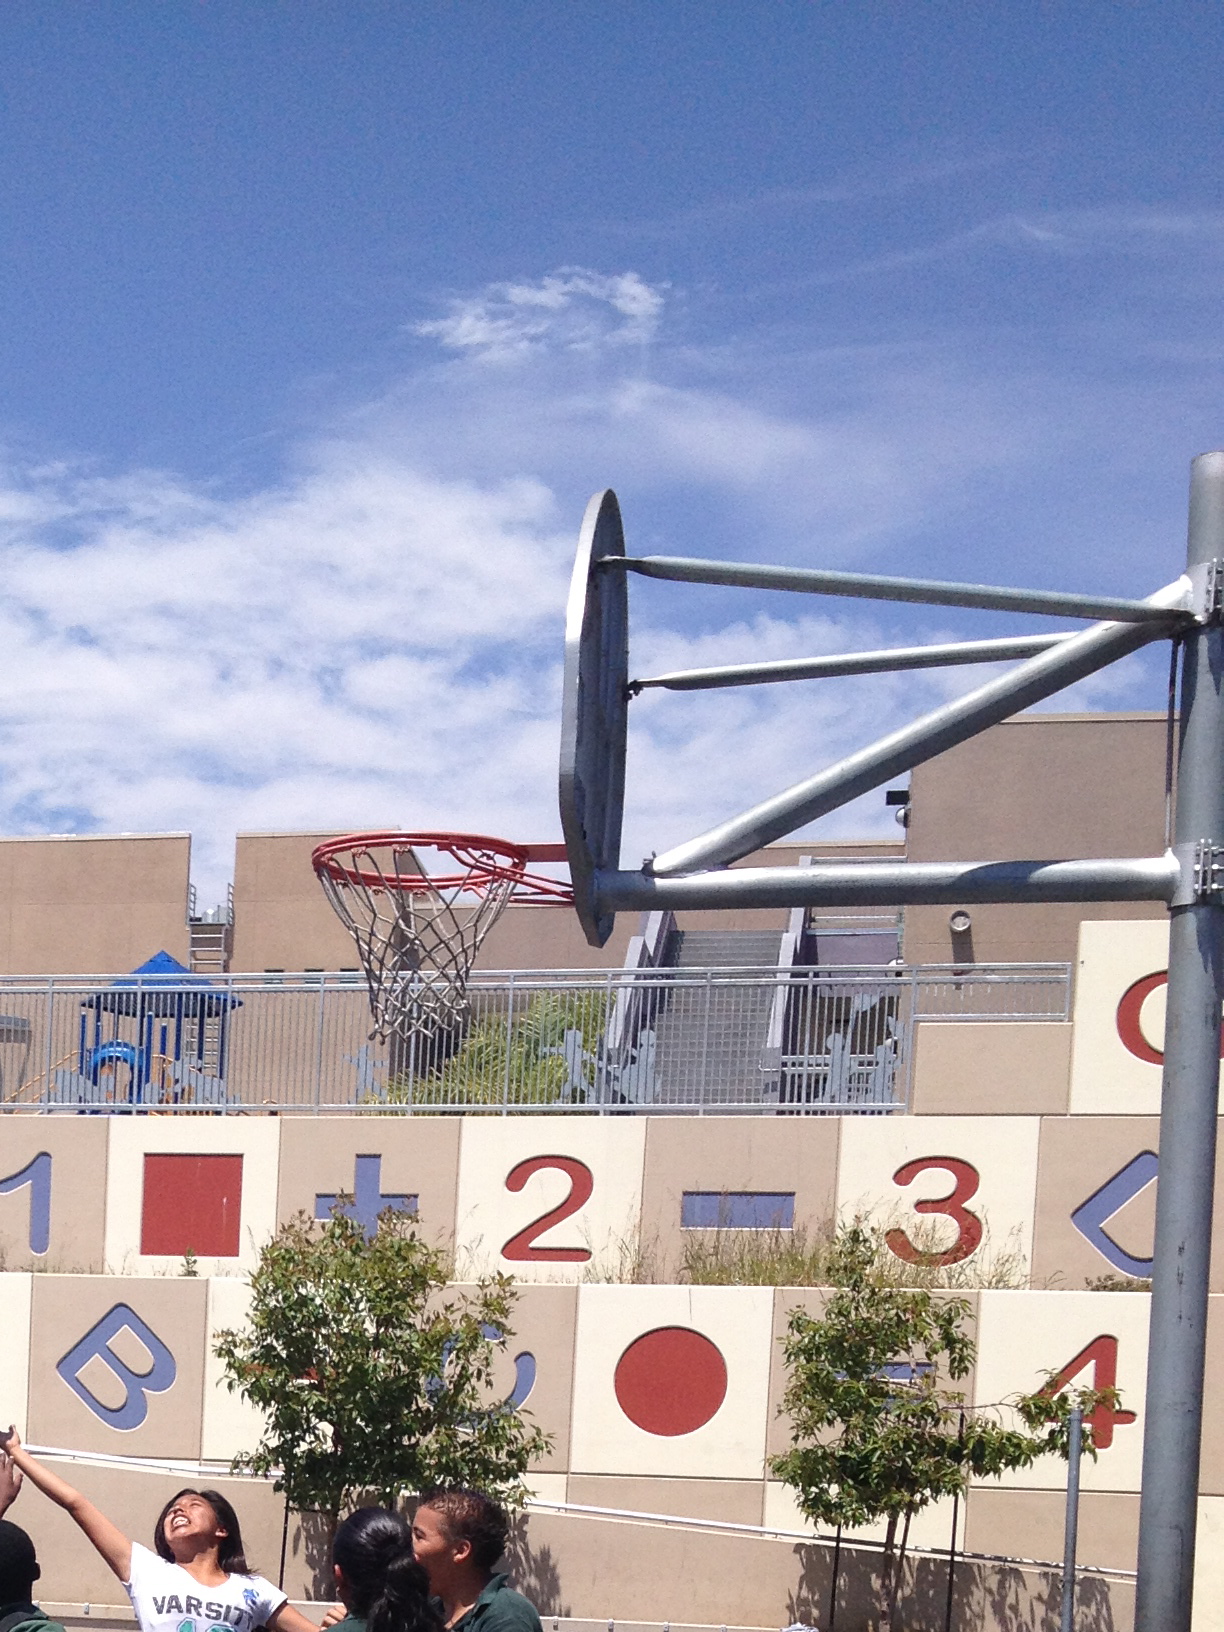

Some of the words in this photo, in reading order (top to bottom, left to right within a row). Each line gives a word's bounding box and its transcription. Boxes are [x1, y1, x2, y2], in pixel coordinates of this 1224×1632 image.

[501, 1154, 594, 1262] 2
[884, 1155, 983, 1267] 3
[56, 1302, 177, 1432] B
[1022, 1334, 1137, 1449] 4
